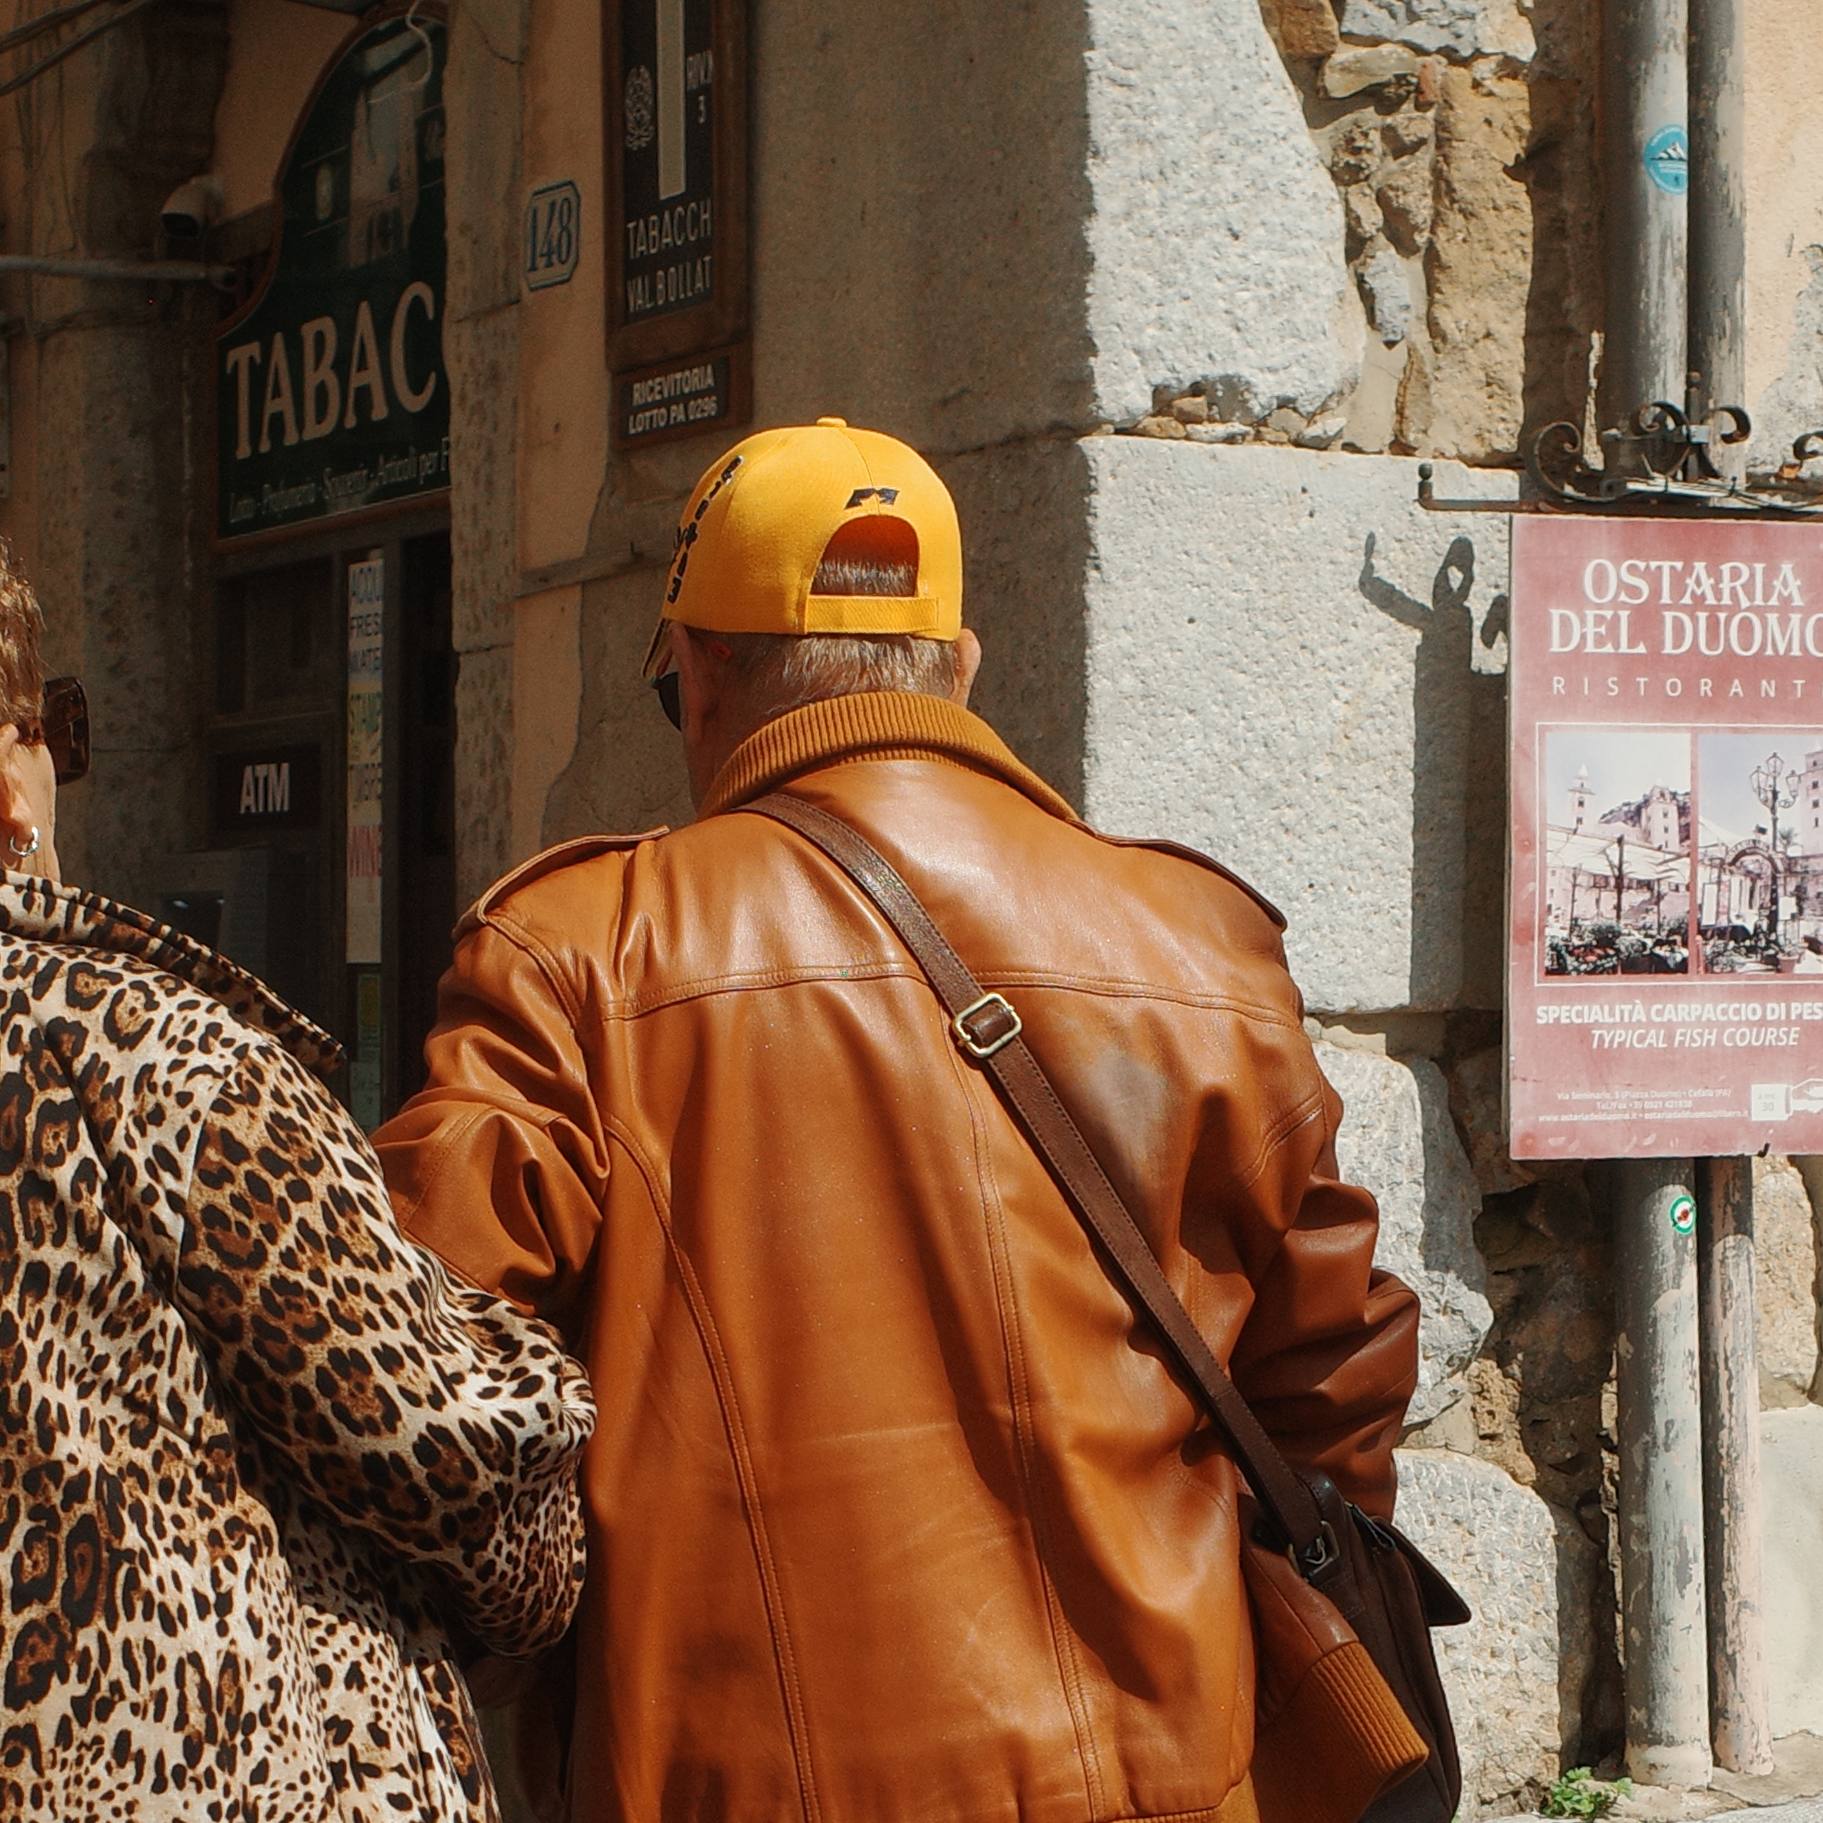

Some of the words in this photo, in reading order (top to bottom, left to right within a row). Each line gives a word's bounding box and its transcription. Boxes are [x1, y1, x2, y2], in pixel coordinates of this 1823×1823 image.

[528, 197, 572, 273] 148
[226, 280, 437, 460] TABAC
[632, 363, 715, 406] RICEVITORIA
[628, 406, 668, 435] LOTTO
[669, 402, 686, 426] PA
[1583, 558, 1804, 609] OSTARIA
[1549, 608, 1647, 655] DEL
[239, 762, 290, 815] ATM
[1536, 999, 1647, 1025] SPECIALITÀ
[1650, 1002, 1764, 1024] CARPACCIO
[1766, 1002, 1787, 1022] DI
[1590, 1029, 1671, 1049] TYPICAL
[1674, 1028, 1718, 1048] FISH
[1720, 1026, 1800, 1047] COURSE
[1762, 1102, 1775, 1112] 30
